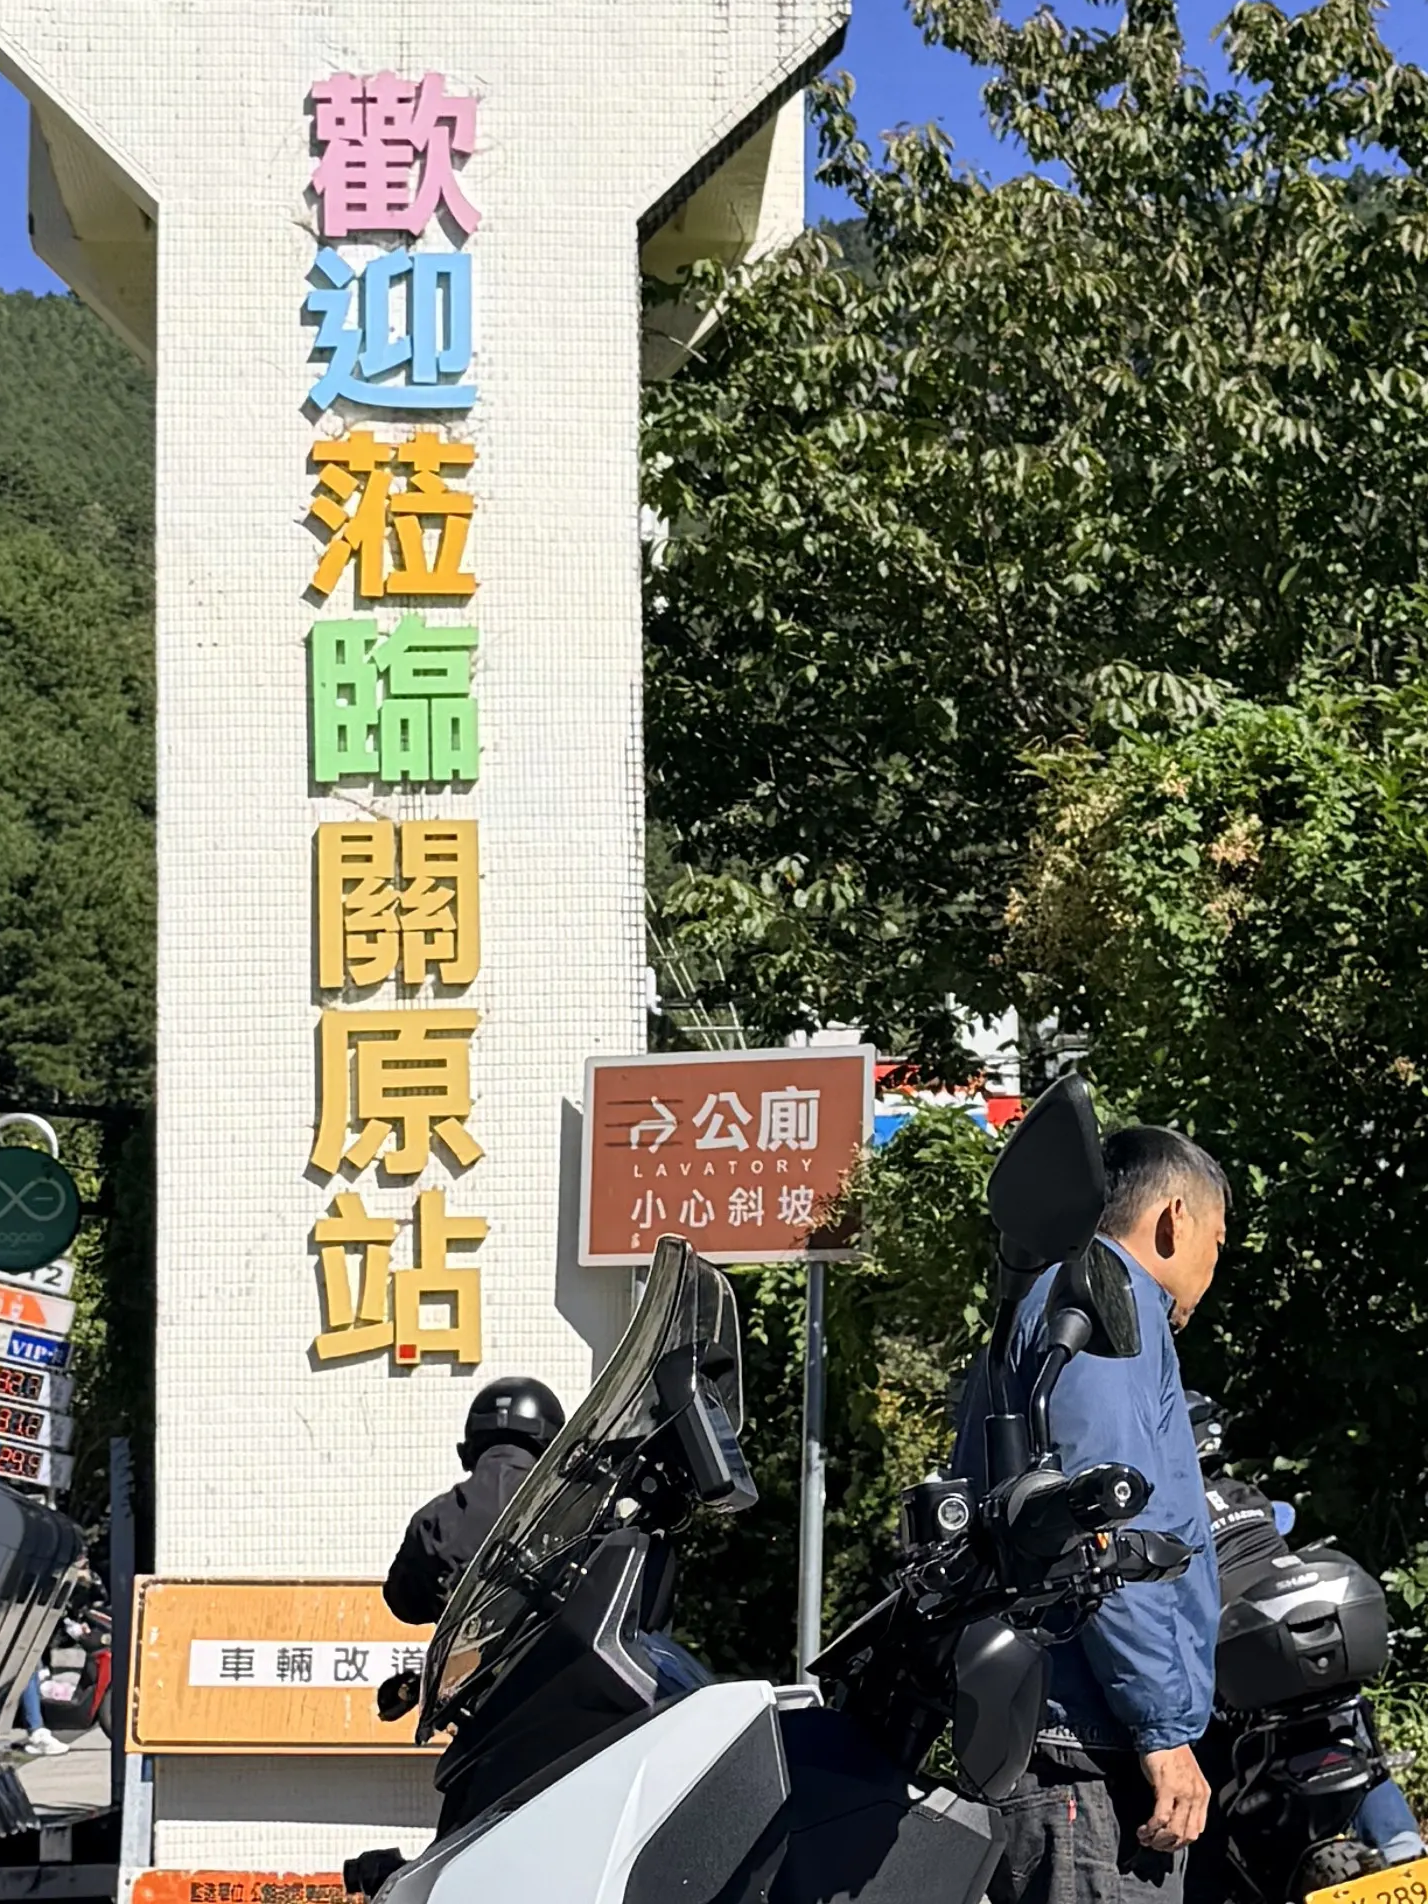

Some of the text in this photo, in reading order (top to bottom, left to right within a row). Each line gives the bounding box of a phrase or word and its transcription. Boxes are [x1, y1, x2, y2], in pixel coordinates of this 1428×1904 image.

[307, 70, 487, 1365] 歡迎蒞臨關原站
[692, 1085, 821, 1152] 公廁
[633, 1158, 813, 1179] LAVATORY
[630, 1184, 816, 1230] 小心斜坡
